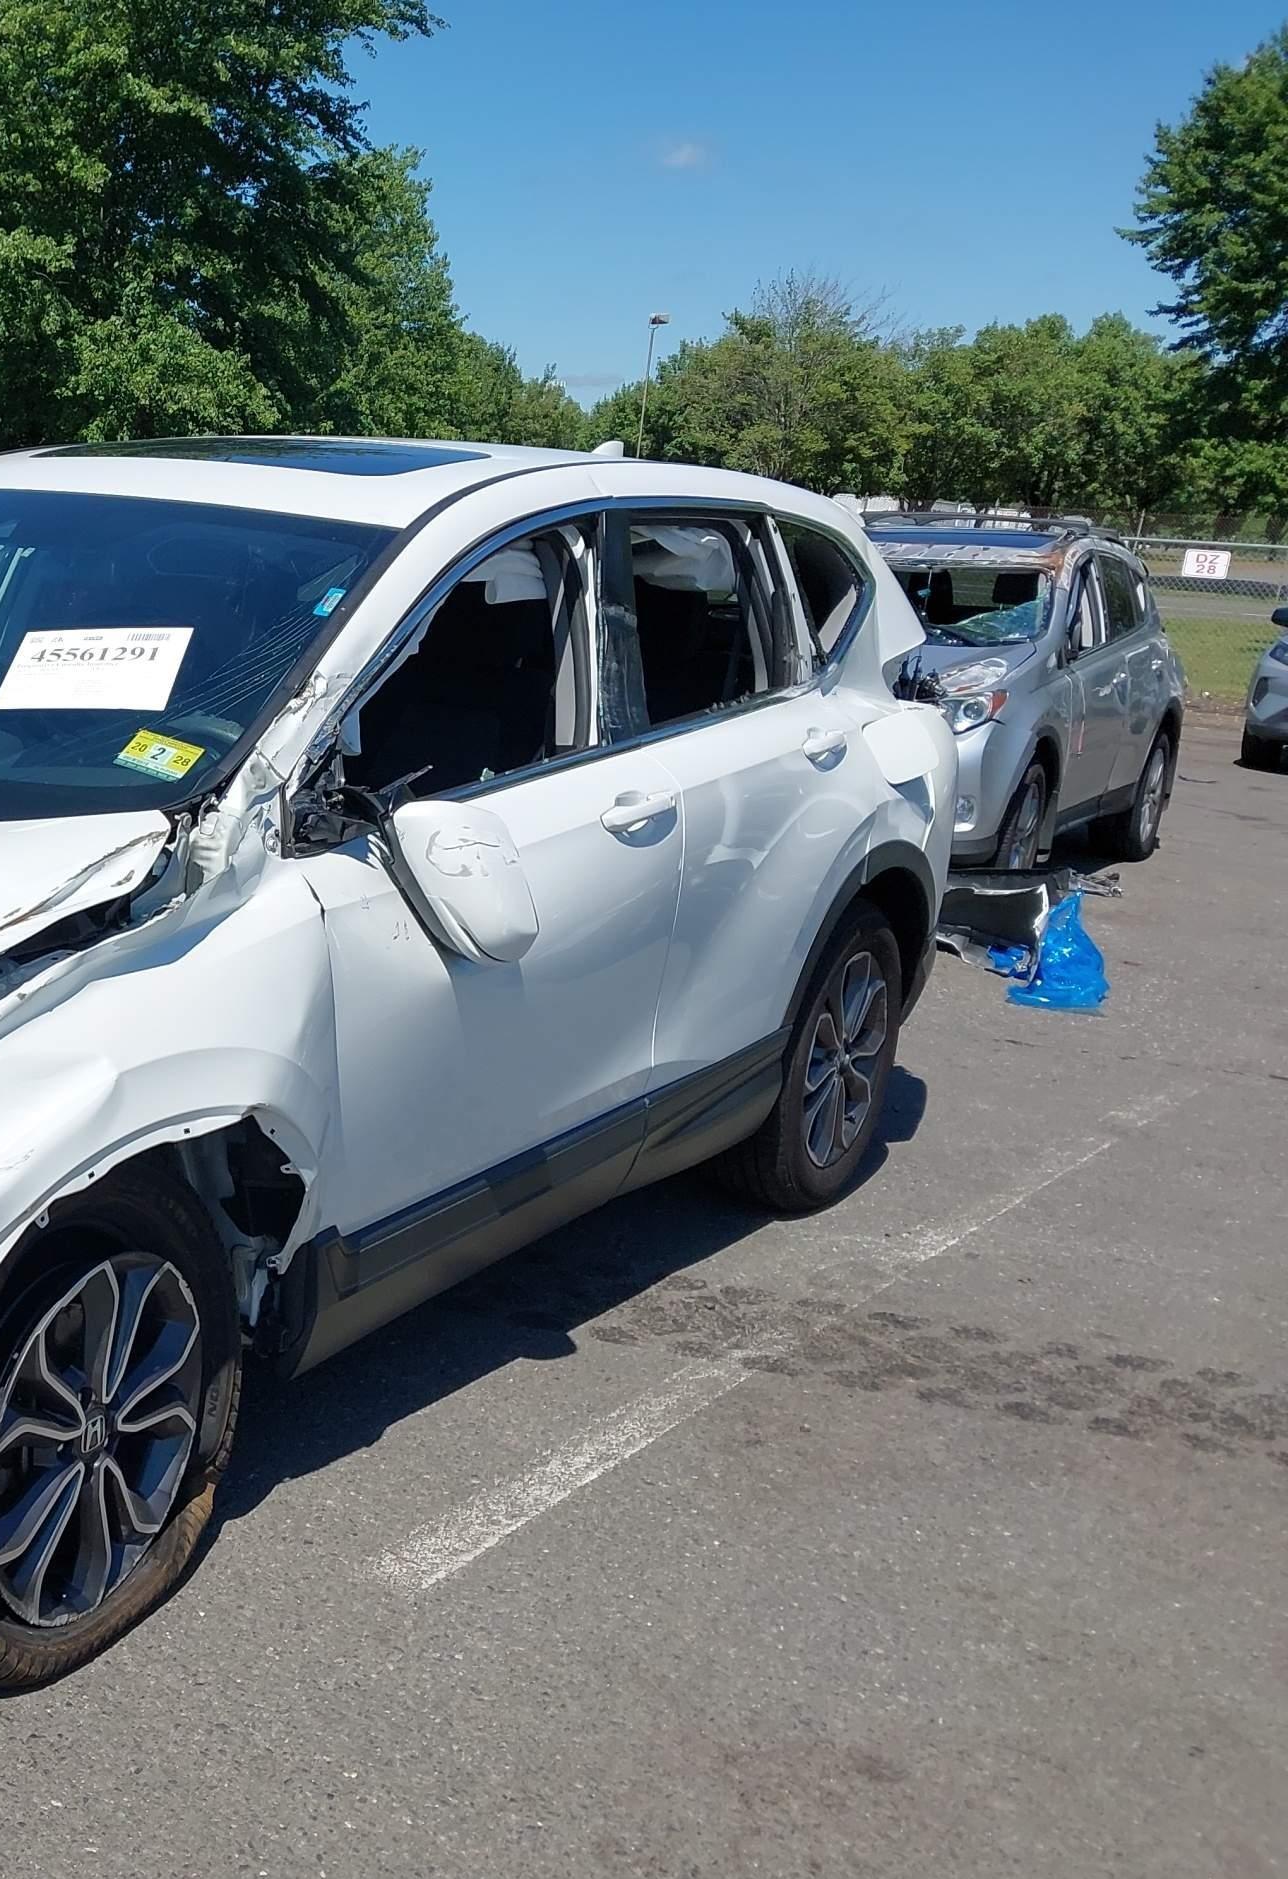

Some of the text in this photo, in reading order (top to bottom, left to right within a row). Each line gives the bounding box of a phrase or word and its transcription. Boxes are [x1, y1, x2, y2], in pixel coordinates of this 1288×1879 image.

[1196, 553, 1220, 564] DZ
[1195, 565, 1217, 575] 28
[30, 647, 160, 663] 45561291
[131, 741, 148, 753] 20
[150, 747, 166, 760] 2
[173, 755, 191, 767] 28
